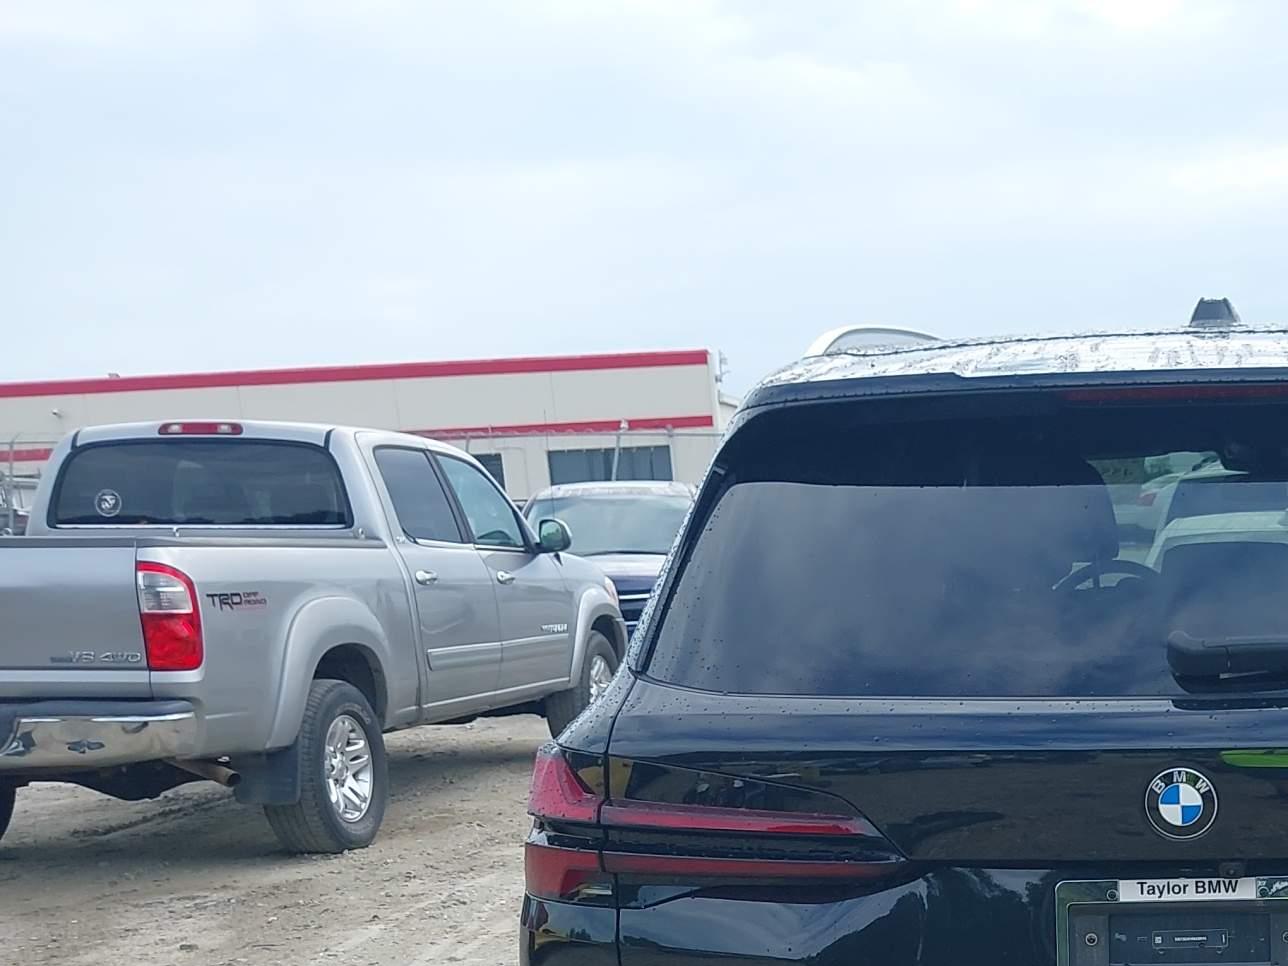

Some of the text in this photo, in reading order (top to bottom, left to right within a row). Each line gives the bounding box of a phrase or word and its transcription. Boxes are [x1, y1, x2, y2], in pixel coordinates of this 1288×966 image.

[206, 593, 243, 611] TRD
[99, 652, 142, 663] 4WD
[1152, 771, 1210, 794] BMW
[1136, 880, 1239, 899] Taylor BMW
